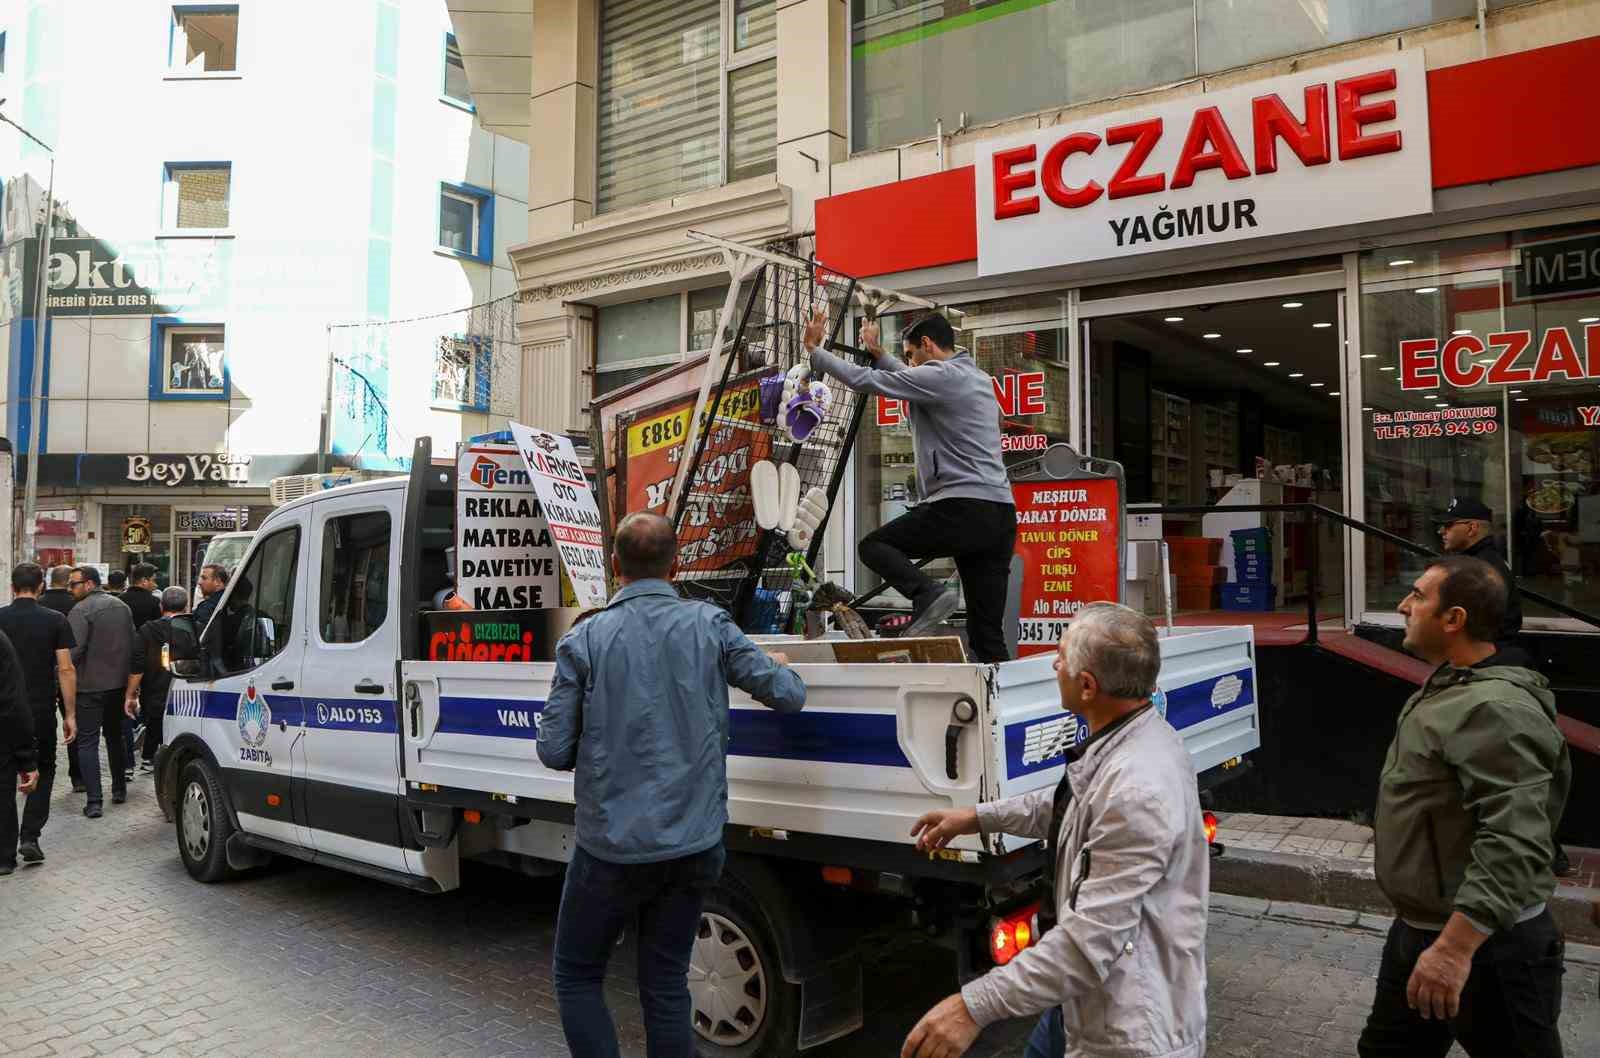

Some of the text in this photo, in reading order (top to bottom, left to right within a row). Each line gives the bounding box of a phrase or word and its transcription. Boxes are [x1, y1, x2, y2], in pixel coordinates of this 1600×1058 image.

[994, 69, 1402, 221] ECZANE
[1109, 198, 1258, 247] YAĞMUR
[46, 293, 86, 308] İREBİR
[89, 292, 115, 307] ÖZEL
[118, 293, 147, 307] DERS
[641, 415, 682, 448] 9383
[1375, 419, 1498, 440] TLF: 214 94 90
[552, 482, 577, 502] OTO
[1032, 489, 1087, 506] MEŞHUR
[1016, 506, 1106, 524] SARAY DÖNER
[463, 528, 553, 547] MATBAA
[1021, 529, 1098, 543] TAVUK DÖNER
[1046, 546, 1071, 559] CİPS
[462, 553, 554, 577] DAVETİYE
[1040, 563, 1076, 577] TURŞU
[1044, 580, 1072, 592] EZME
[1033, 599, 1050, 615] Alo
[330, 706, 382, 724] ALO 153
[497, 709, 530, 728] VAN
[240, 747, 271, 762] ZABITA
